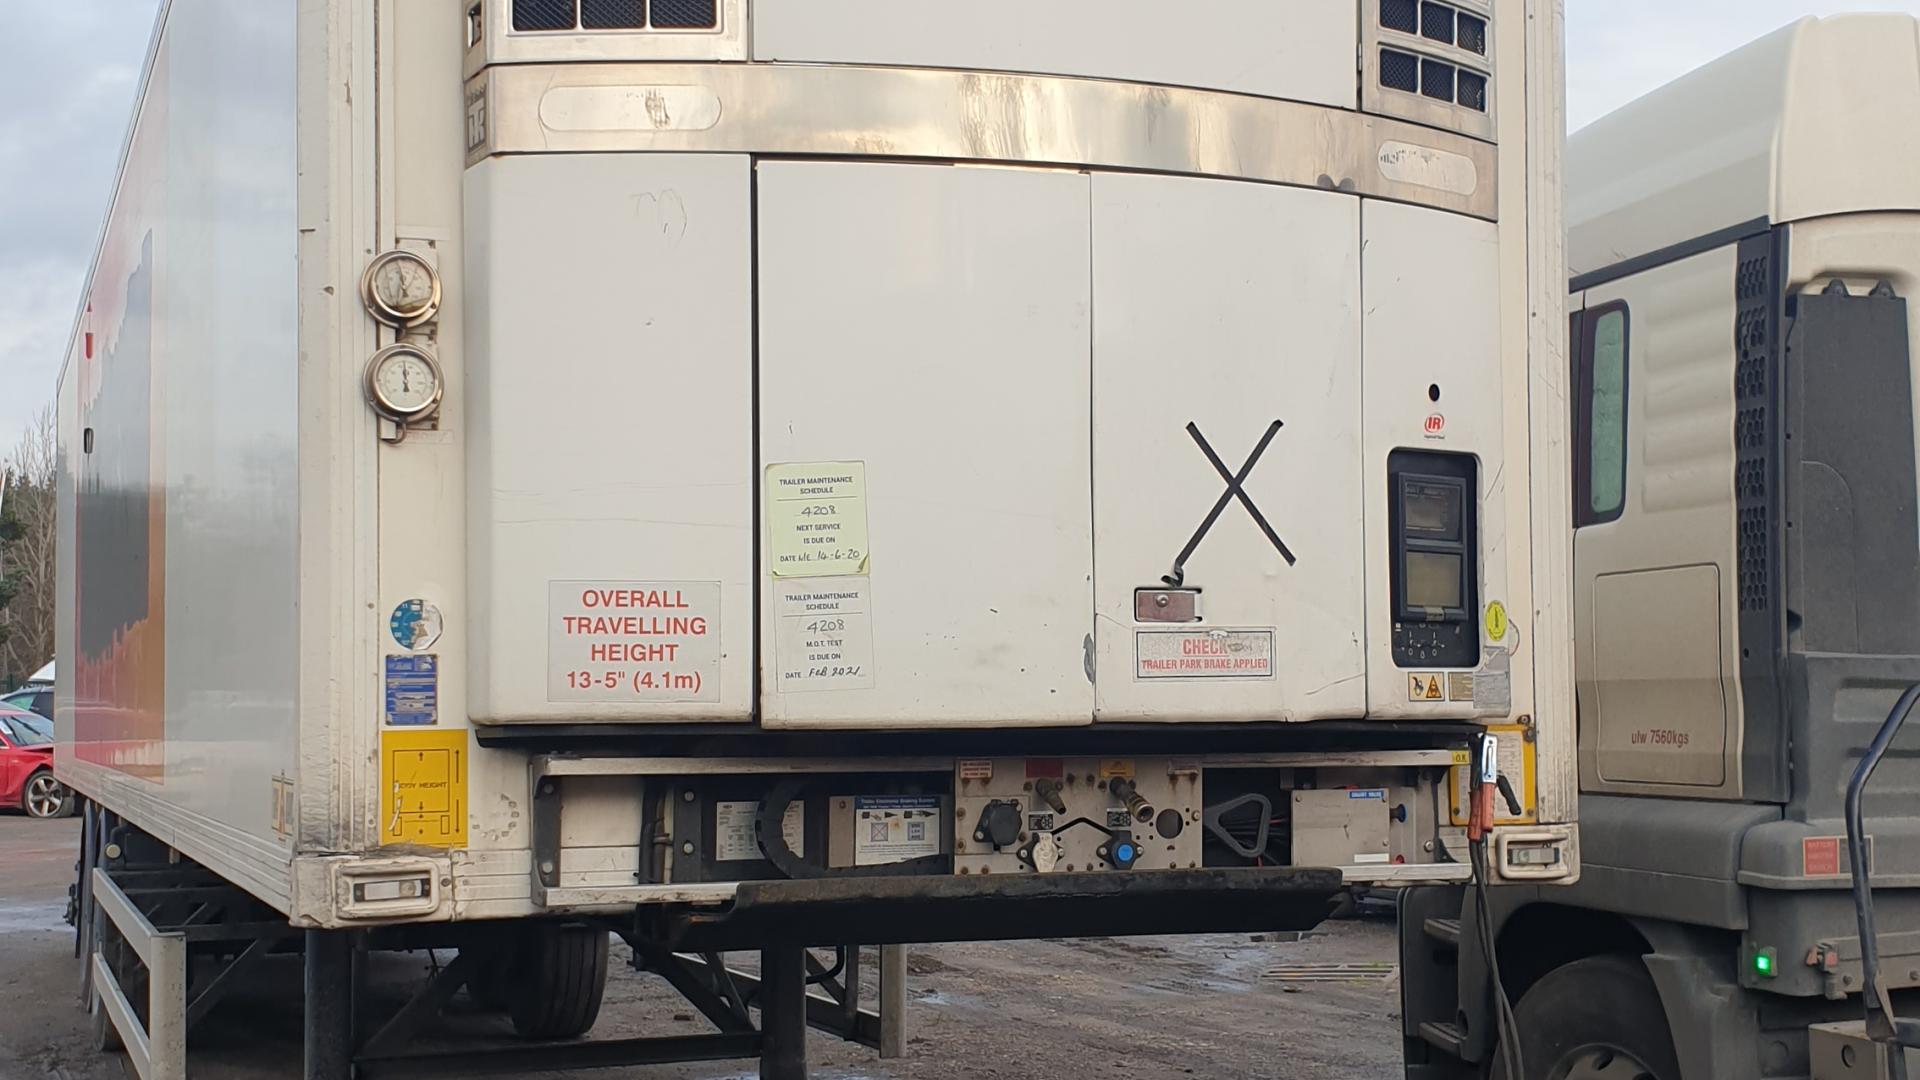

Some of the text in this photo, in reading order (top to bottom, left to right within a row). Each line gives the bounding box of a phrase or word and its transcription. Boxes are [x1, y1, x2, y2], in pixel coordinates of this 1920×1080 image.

[807, 476, 853, 484] MAINTENANCE
[800, 486, 834, 494] SCHEDULE
[801, 504, 836, 517] 4208
[582, 590, 689, 607] OVERALL
[813, 592, 859, 600] MAINTENANCE
[563, 617, 706, 634] TRAVELLING
[807, 619, 845, 634] 4208
[591, 644, 679, 661] HEIGHT
[1183, 639, 1229, 654] CHECK
[1142, 658, 1268, 670] TRAILER PARK BRAKE APPLIED
[831, 666, 861, 677] 2021
[567, 671, 701, 693] 13-5" (4.1m)
[1650, 729, 1689, 749] 7560kgs
[419, 781, 448, 789] HEIGHT
